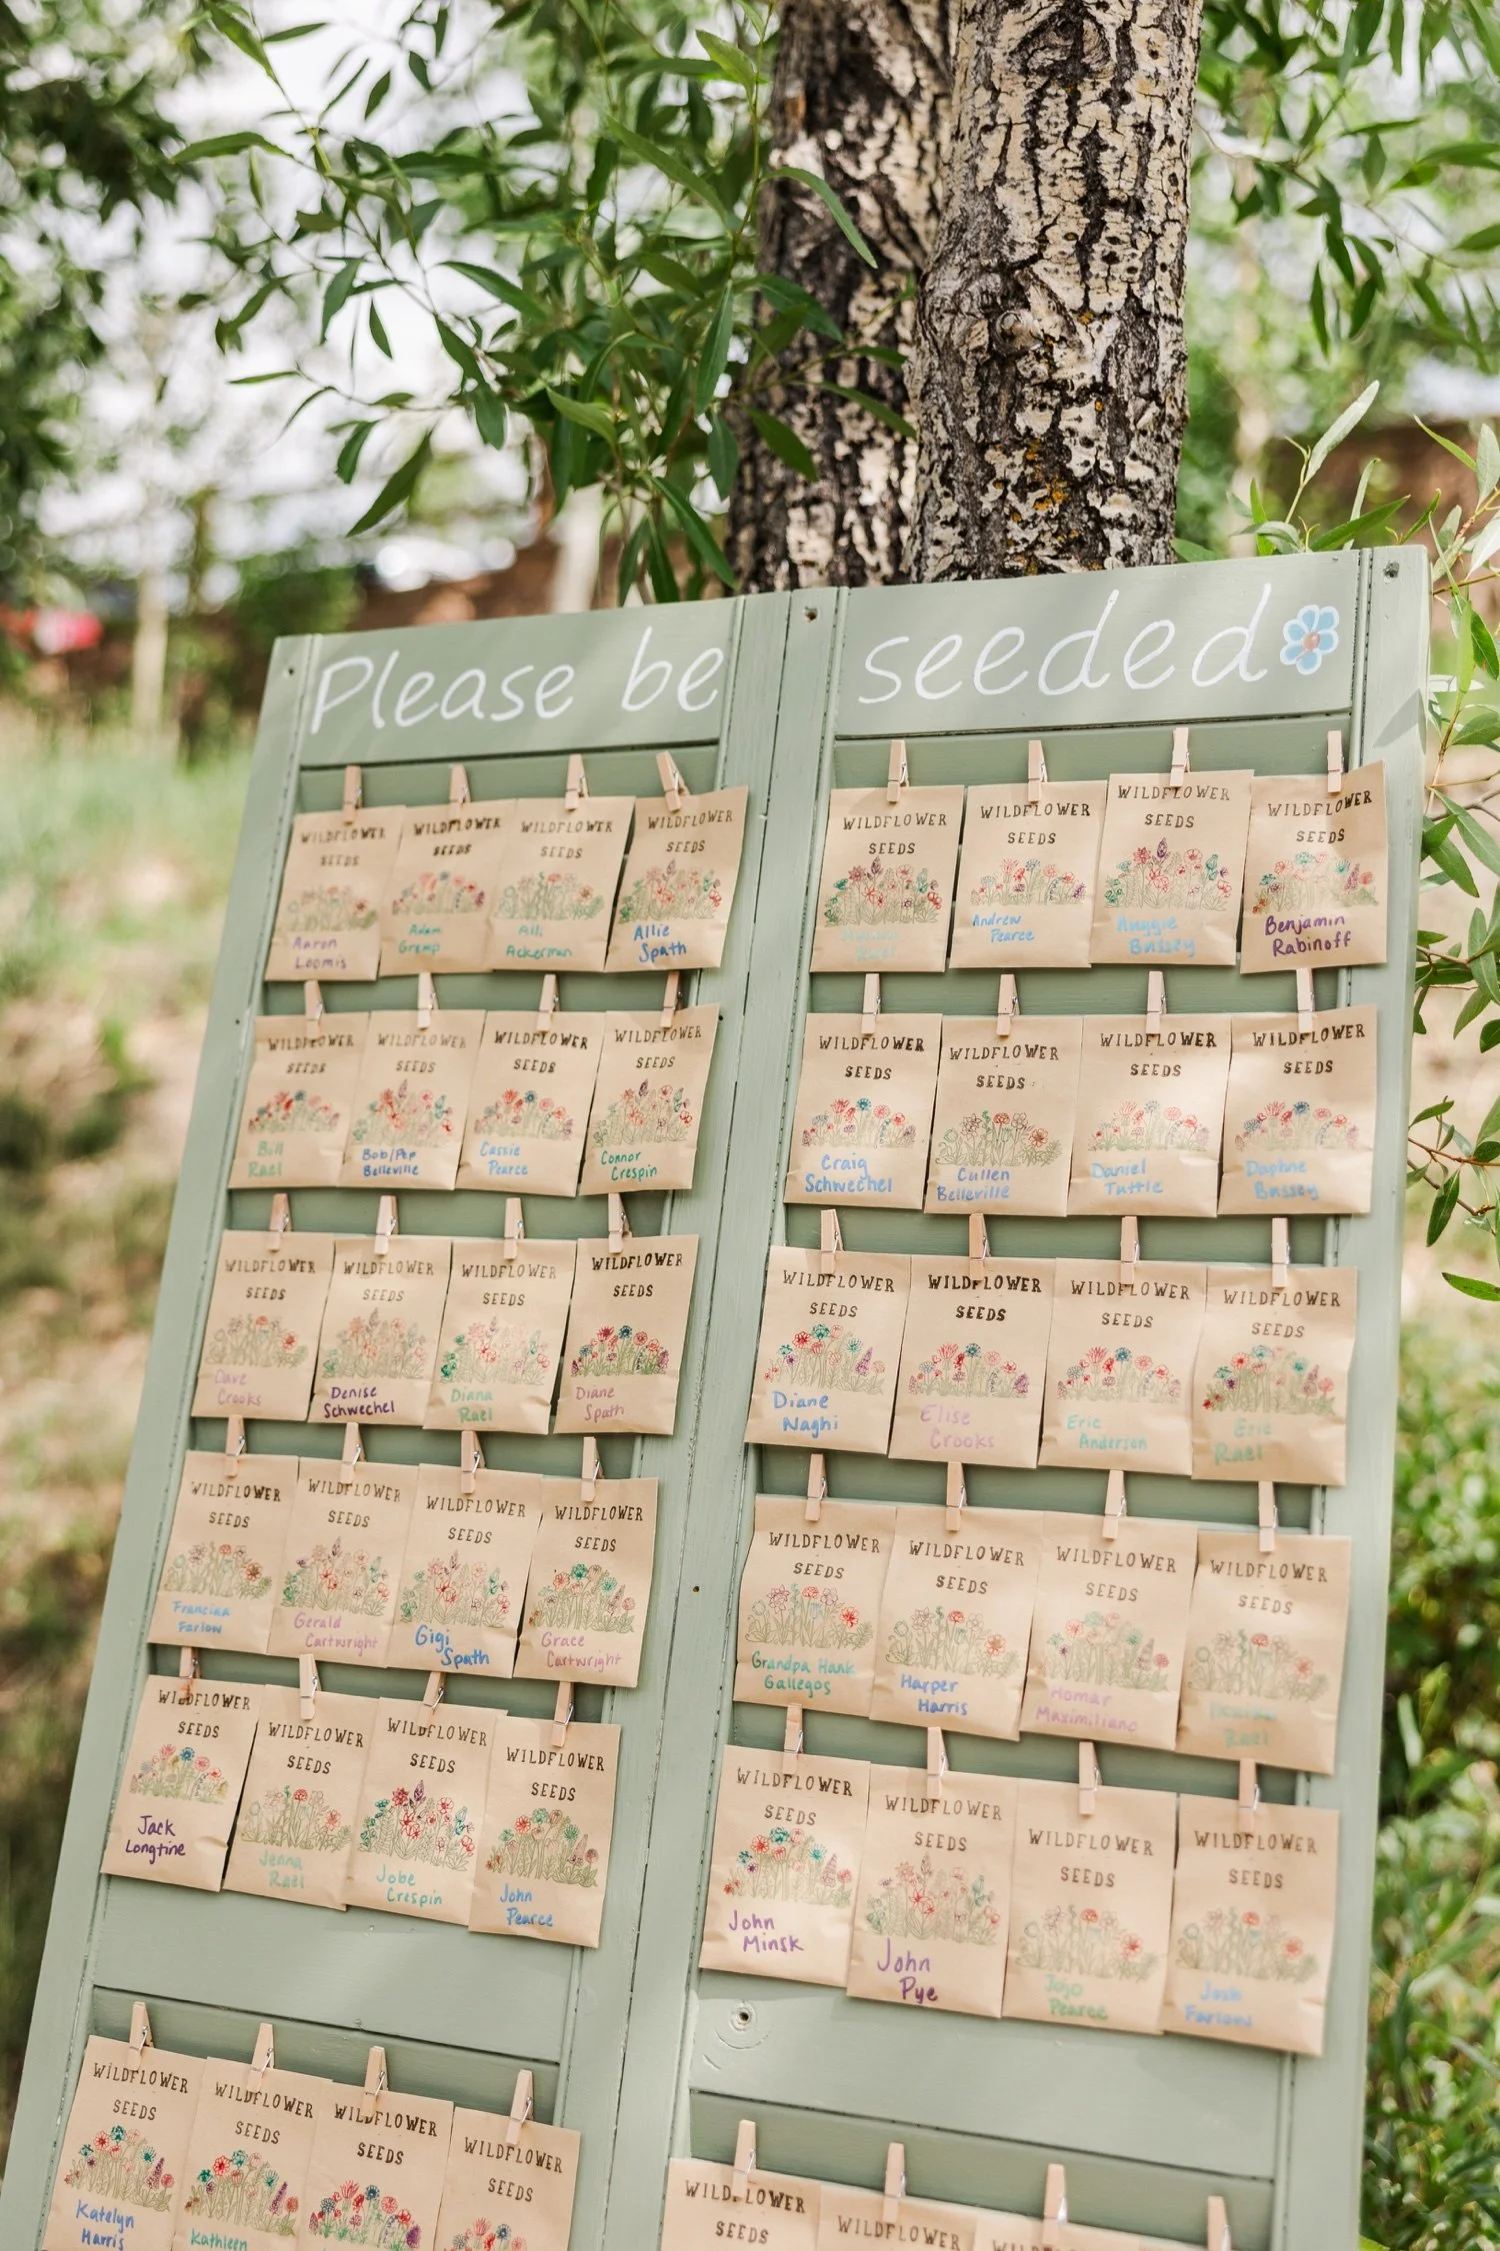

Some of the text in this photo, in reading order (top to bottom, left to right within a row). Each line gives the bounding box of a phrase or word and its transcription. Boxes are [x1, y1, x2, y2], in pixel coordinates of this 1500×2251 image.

[311, 583, 1272, 734] Please be seeded
[1117, 784, 1230, 801] WILDFLOWER
[980, 802, 1090, 820] WILDFLOWER
[1268, 790, 1373, 817] WILDFLOWER
[520, 820, 612, 834] WILDFLOWER
[648, 810, 733, 830] WILDFLOWER
[843, 812, 948, 830] WILDFLOWER
[1144, 814, 1194, 828] SEEDS
[1008, 832, 1056, 845] SEEDS
[1296, 829, 1345, 844] SEEDS
[540, 846, 583, 859] SEEDS
[666, 840, 706, 853] SEEDS
[869, 842, 916, 856] SEEDS
[972, 914, 1022, 927] Andrew
[1264, 914, 1346, 936] Benjamin
[633, 924, 670, 942] Allie
[990, 928, 1035, 943] Pearce
[292, 936, 338, 950] Aaron
[506, 945, 572, 960] Ackerman
[638, 942, 687, 963] Spath
[1272, 931, 1351, 957] Rabinoff
[294, 951, 348, 970] Loomis
[494, 1030, 588, 1050] WILDFLOWER
[614, 1026, 702, 1043] WILDFLOWER
[819, 1036, 925, 1051] WILDFLOWER
[1101, 1032, 1217, 1049] WILDFLOWER
[1253, 1024, 1365, 1047] WILDFLOWER
[636, 1056, 675, 1069] SEEDS
[950, 1045, 1059, 1061] WILDFLOWER
[396, 1060, 436, 1073] SEEDS
[513, 1058, 556, 1074] SEEDS
[845, 1066, 892, 1080] SEEDS
[1130, 1064, 1181, 1077] SEEDS
[1283, 1060, 1333, 1074] SEEDS
[976, 1075, 1025, 1089] SEEDS
[480, 1141, 520, 1157] Cassie
[601, 1151, 641, 1164] Connor
[249, 1163, 283, 1176] Rael
[488, 1160, 528, 1175] Pearce
[611, 1164, 657, 1181] Crespin
[821, 1153, 867, 1180] Craig
[958, 1168, 1010, 1182] Cullen
[1091, 1158, 1146, 1179] Daniel
[1246, 1159, 1307, 1178] Daphne
[805, 1174, 892, 1194] Schwechel
[937, 1185, 1010, 1200] Belleville
[1105, 1180, 1163, 1195] Tuttle
[225, 1259, 316, 1273] WILDFLOWER
[344, 1260, 434, 1276] WILDFLOWER
[462, 1263, 556, 1279] WILDFLOWER
[592, 1253, 683, 1271] WILDFLOWER
[613, 1284, 653, 1297] SEEDS
[783, 1270, 894, 1292] WILDFLOWER
[928, 1274, 1042, 1292] WILDFLOWER
[1071, 1280, 1191, 1300] WILDFLOWER
[246, 1287, 286, 1301] SEEDS
[363, 1288, 405, 1302] SEEDS
[483, 1293, 525, 1306] SEEDS
[1223, 1289, 1341, 1307] WILDFLOWER
[810, 1302, 858, 1317] SEEDS
[956, 1306, 1006, 1321] SEEDS
[1102, 1313, 1154, 1328] SEEDS
[1252, 1323, 1305, 1338] SEEDS
[331, 1386, 377, 1400] Denise
[576, 1386, 615, 1400] Diane
[773, 1390, 828, 1409] Diane
[324, 1400, 395, 1419] Schwechel
[457, 1407, 492, 1422] Rael
[584, 1404, 625, 1422] Spath
[920, 1404, 970, 1424] Elise
[783, 1416, 838, 1438] Naghi
[1067, 1414, 1102, 1430] Eric
[930, 1430, 994, 1450] Crooks
[1080, 1433, 1147, 1449] Anderson
[191, 1481, 281, 1501] WILDFLOWER
[308, 1479, 400, 1502] WILDFLOWER
[426, 1496, 526, 1517] WILDFLOWER
[555, 1506, 643, 1522] WILDFLOWER
[209, 1512, 250, 1528] SEEDS
[328, 1510, 370, 1528] SEEDS
[448, 1527, 492, 1544] SEEDS
[575, 1536, 616, 1552] SEEDS
[768, 1532, 880, 1554] WILDFLOWER
[909, 1540, 1024, 1566] WILDFLOWER
[1056, 1546, 1176, 1573] WILDFLOWER
[793, 1563, 844, 1580] SEEDS
[1210, 1559, 1328, 1583] WILDFLOWER
[936, 1575, 988, 1594] SEEDS
[1085, 1582, 1138, 1602] SEEDS
[1237, 1595, 1293, 1615] SEEDS
[294, 1614, 342, 1629] Gerald
[305, 1632, 379, 1656] Cartwright
[415, 1624, 449, 1649] Gigi
[541, 1632, 585, 1648] Grace
[440, 1650, 490, 1669] Spath
[547, 1652, 622, 1672] Cartwright
[752, 1651, 855, 1675] Grandpa Hank
[764, 1675, 831, 1695] Gallegos
[901, 1675, 958, 1694] Harper
[918, 1699, 968, 1716] Harris
[1036, 1706, 1138, 1733] Maximiliano
[178, 1721, 220, 1738] SEEDS
[268, 1723, 363, 1748] WILDFLOWER
[388, 1717, 487, 1746] WILDFLOWER
[288, 1755, 331, 1774] SEEDS
[410, 1753, 456, 1773] SEEDS
[507, 1746, 604, 1771] WILDFLOWER
[737, 1767, 853, 1796] WILDFLOWER
[532, 1782, 576, 1801] SEEDS
[764, 1804, 816, 1825] SEEDS
[885, 1795, 1002, 1821] WILDFLOWER
[138, 1815, 175, 1836] Jack
[915, 1831, 967, 1852] SEEDS
[1029, 1828, 1154, 1856] WILDFLOWER
[1194, 1830, 1318, 1855] WILDFLOWER
[126, 1839, 186, 1864] Longtine
[260, 1852, 303, 1870] Jenna
[376, 1864, 415, 1886] Jobe
[1060, 1866, 1115, 1888] SEEDS
[1229, 1869, 1284, 1889] SEEDS
[387, 1887, 442, 1908] Crespin
[500, 1883, 532, 1902] John
[507, 1908, 553, 1926] Pearce
[729, 1910, 775, 1930] John
[743, 1935, 804, 1952] Minsk
[877, 1938, 930, 1973] John
[900, 1976, 938, 2005] Pye
[1044, 1974, 1083, 1997] Jojo
[1049, 1999, 1108, 2021] Pearce
[94, 2062, 188, 2093] WILDFLOWER
[215, 2082, 314, 2118] WILDFLOWER
[113, 2099, 157, 2121] SEEDS
[235, 2121, 281, 2144] SEEDS
[357, 2142, 404, 2165] SEEDS
[464, 2137, 563, 2174] WILDFLOWER
[488, 2177, 533, 2202] SEEDS
[75, 2200, 135, 2229] Katelyn
[82, 2228, 124, 2250] Harris
[716, 2220, 769, 2244] SEEDS
[838, 2214, 959, 2250] WILDFLOWER
